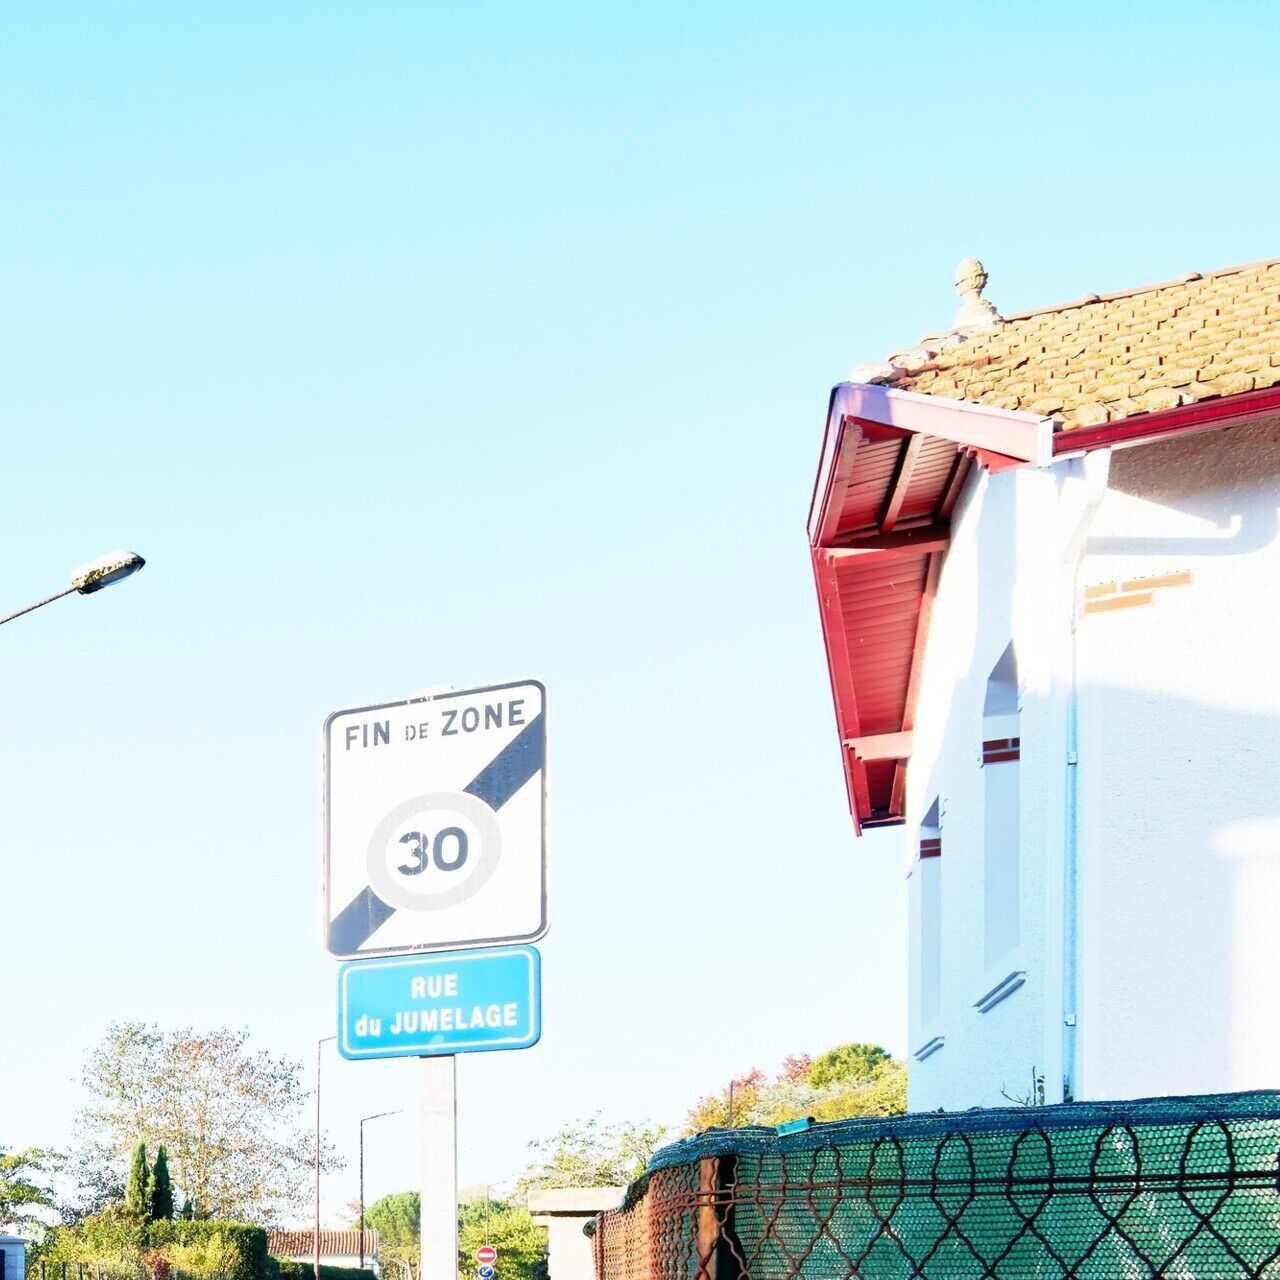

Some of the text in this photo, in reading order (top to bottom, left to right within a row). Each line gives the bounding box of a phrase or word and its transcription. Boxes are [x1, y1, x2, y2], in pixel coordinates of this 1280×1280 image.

[344, 698, 527, 751] FIN DE ZONE
[396, 825, 470, 877] 30
[410, 973, 459, 1000] RUE
[354, 1002, 519, 1038] du JUMELAGE
